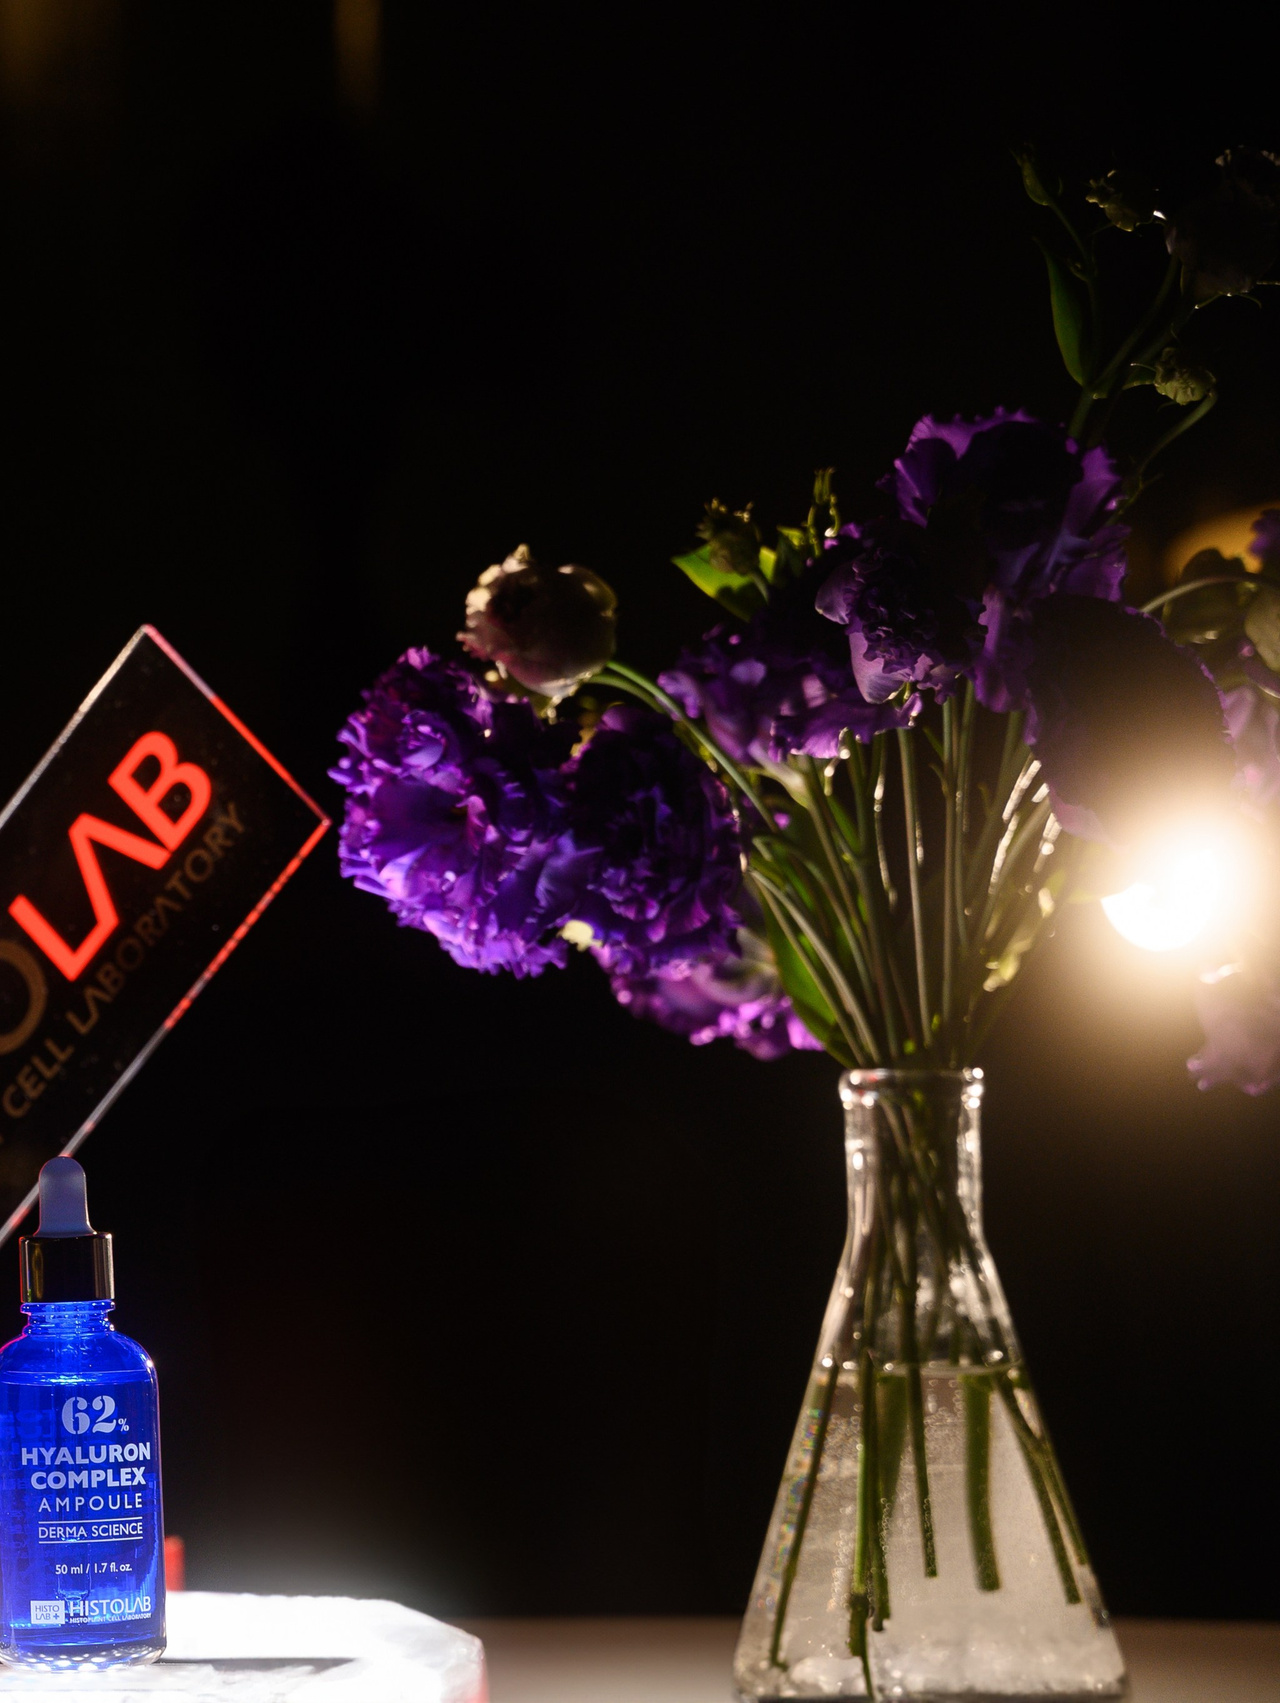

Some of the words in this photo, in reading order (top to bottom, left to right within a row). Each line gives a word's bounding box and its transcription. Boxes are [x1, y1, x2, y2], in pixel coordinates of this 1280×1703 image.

[3, 1038, 75, 1120] CELL
[66, 802, 246, 1035] LABORATORY
[61, 1395, 130, 1435] 62%
[21, 1442, 151, 1466] HYALURON
[30, 1466, 146, 1490] COMPLEX
[38, 1492, 143, 1512] AMPOULE
[38, 1526, 88, 1539] DERMA
[91, 1522, 143, 1537] SCIENCE
[55, 1564, 68, 1574] 50
[70, 1564, 83, 1574] ml
[94, 1563, 107, 1573] 1.7
[70, 1596, 151, 1617] HISTOLAB
